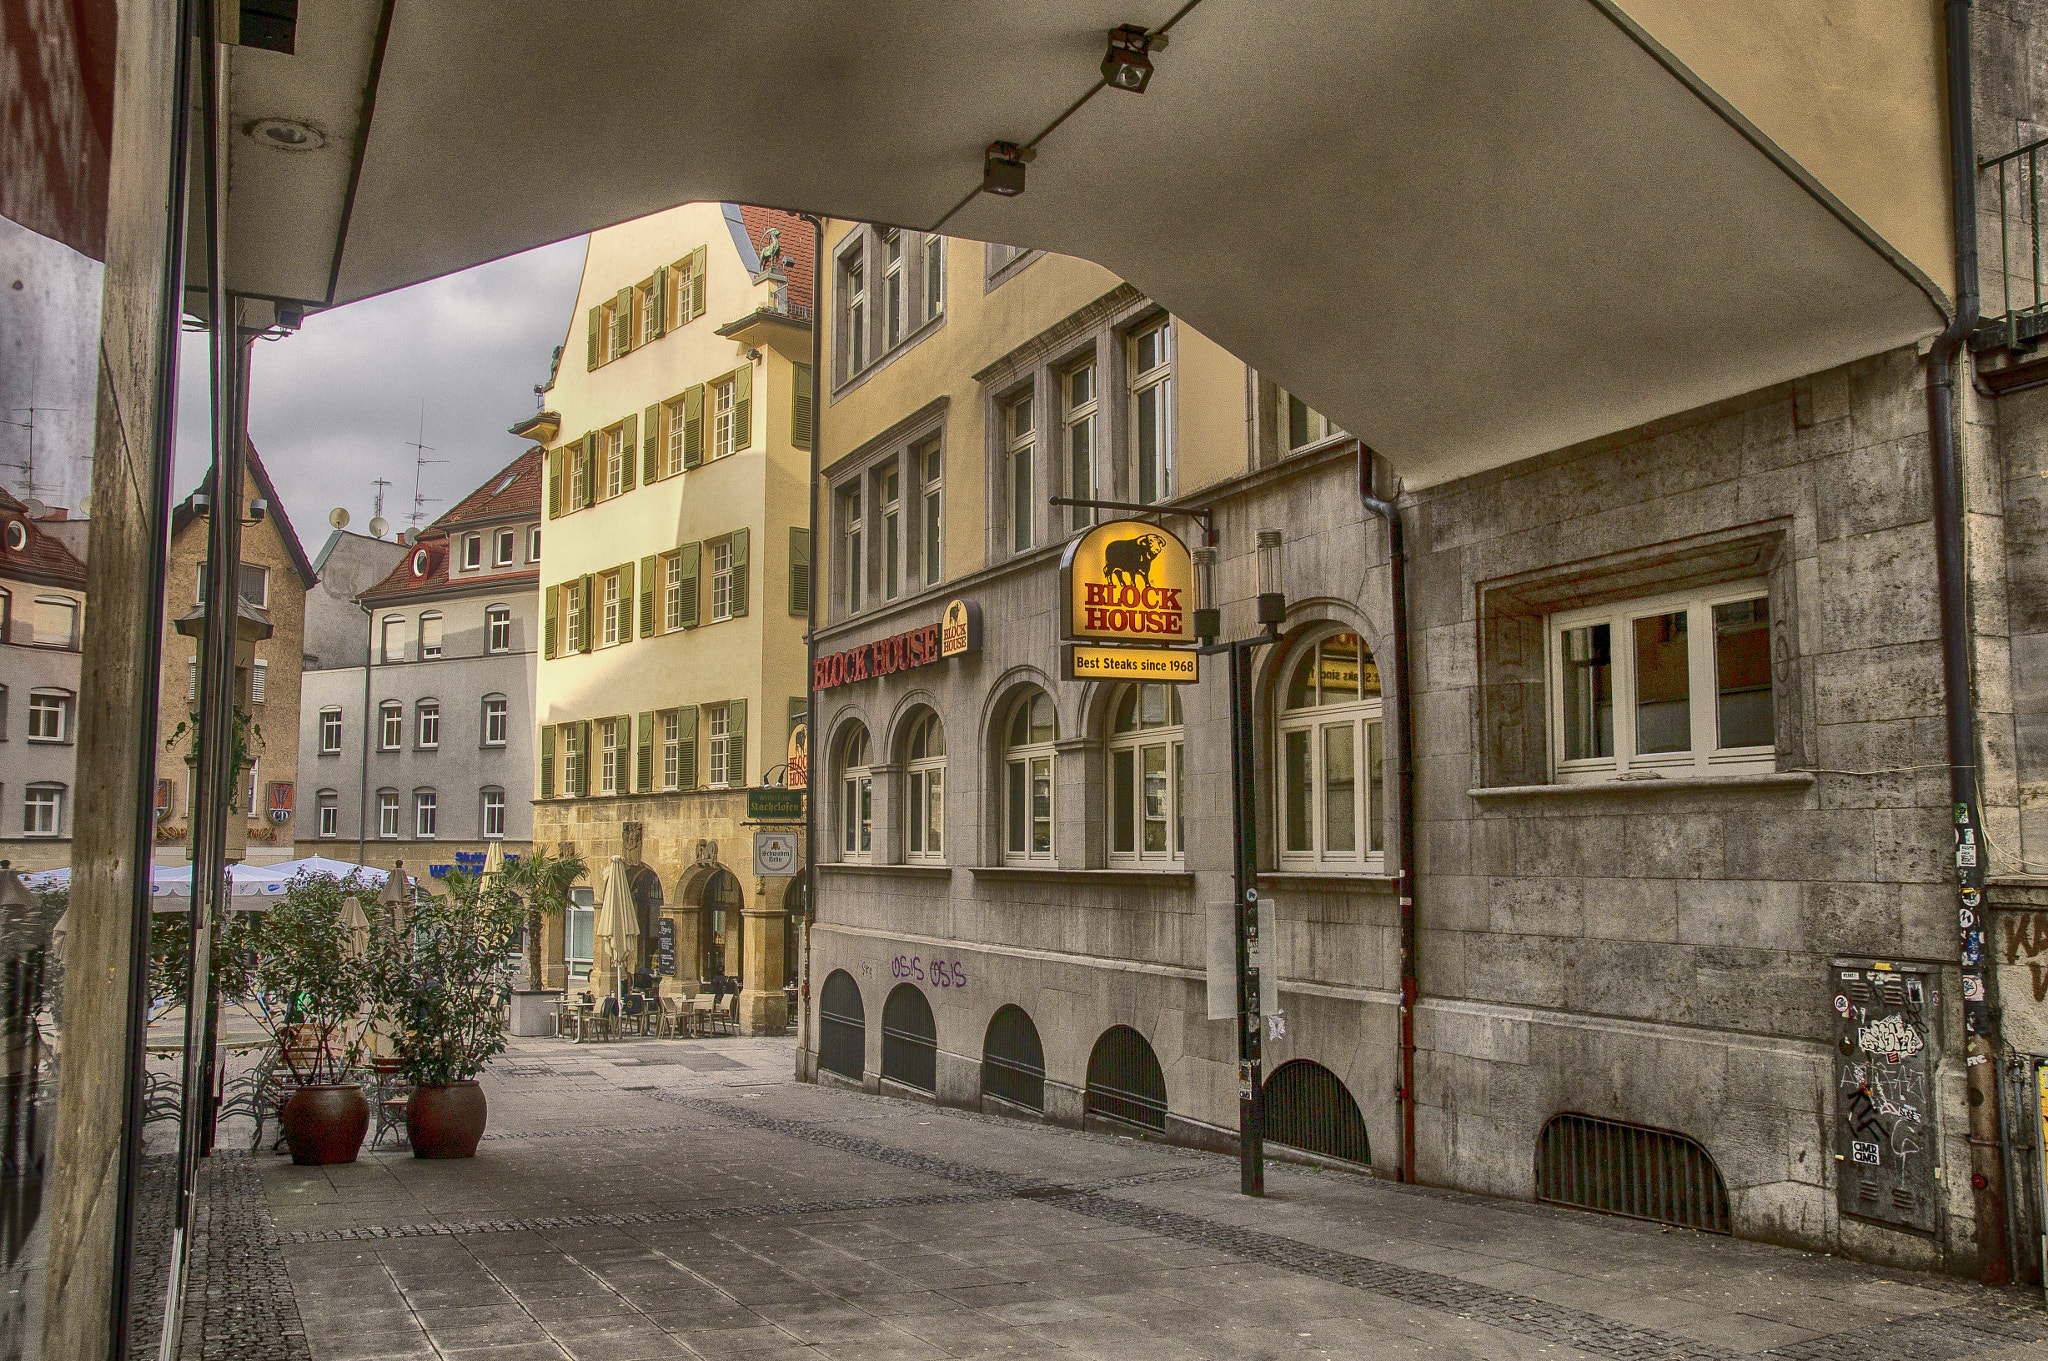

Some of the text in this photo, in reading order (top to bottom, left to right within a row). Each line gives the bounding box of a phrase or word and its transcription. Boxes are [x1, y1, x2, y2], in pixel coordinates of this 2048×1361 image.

[1085, 583, 1182, 610] BLOCK
[1085, 608, 1182, 634] HOUSE
[944, 623, 966, 641] BLOCK
[944, 636, 966, 653] HOUSE
[813, 623, 938, 691] BLOCK HOUSE
[1077, 657, 1193, 672] Best Steaks since 1968
[790, 755, 807, 771] BLOC
[790, 770, 807, 786] HOU
